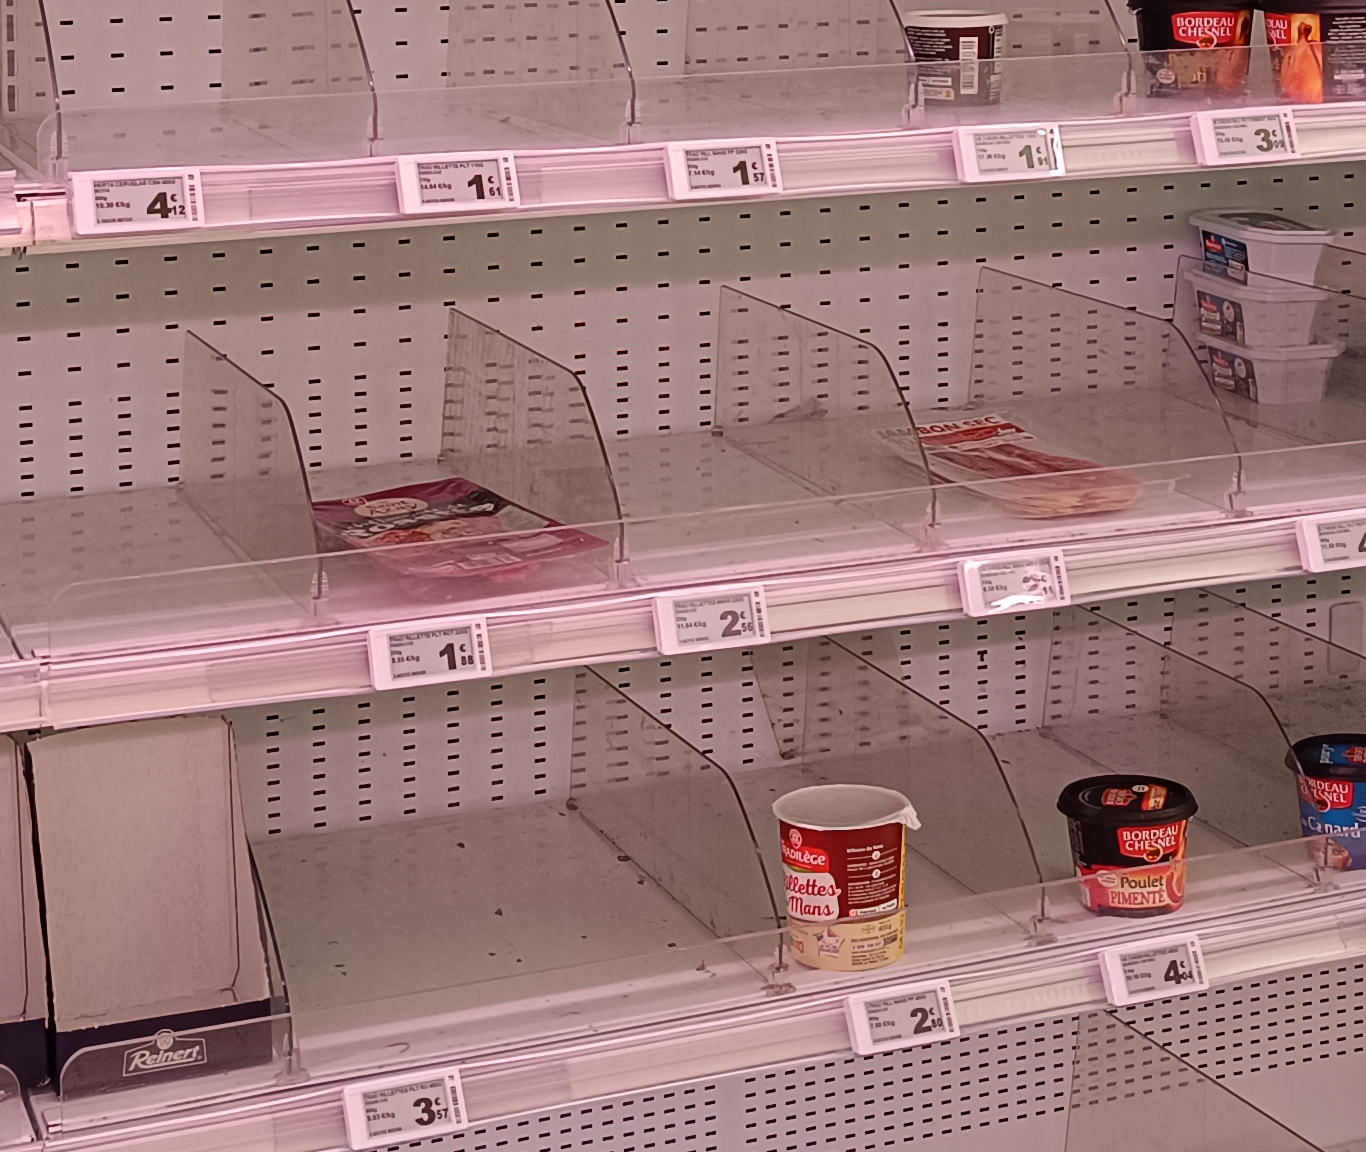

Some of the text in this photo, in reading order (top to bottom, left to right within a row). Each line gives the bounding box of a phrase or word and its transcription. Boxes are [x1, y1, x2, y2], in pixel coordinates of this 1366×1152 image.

[1176, 15, 1235, 29] BORDEAU
[1178, 26, 1233, 38] CHESNEL
[963, 415, 1003, 428] SEC
[1122, 824, 1179, 842] BORDEAU
[1124, 835, 1176, 852] CHESNEL
[1120, 871, 1164, 889] Poulet
[1109, 887, 1166, 906] PIMENTÉ
[797, 895, 835, 917] Mans
[128, 1045, 200, 1071] Reinert
